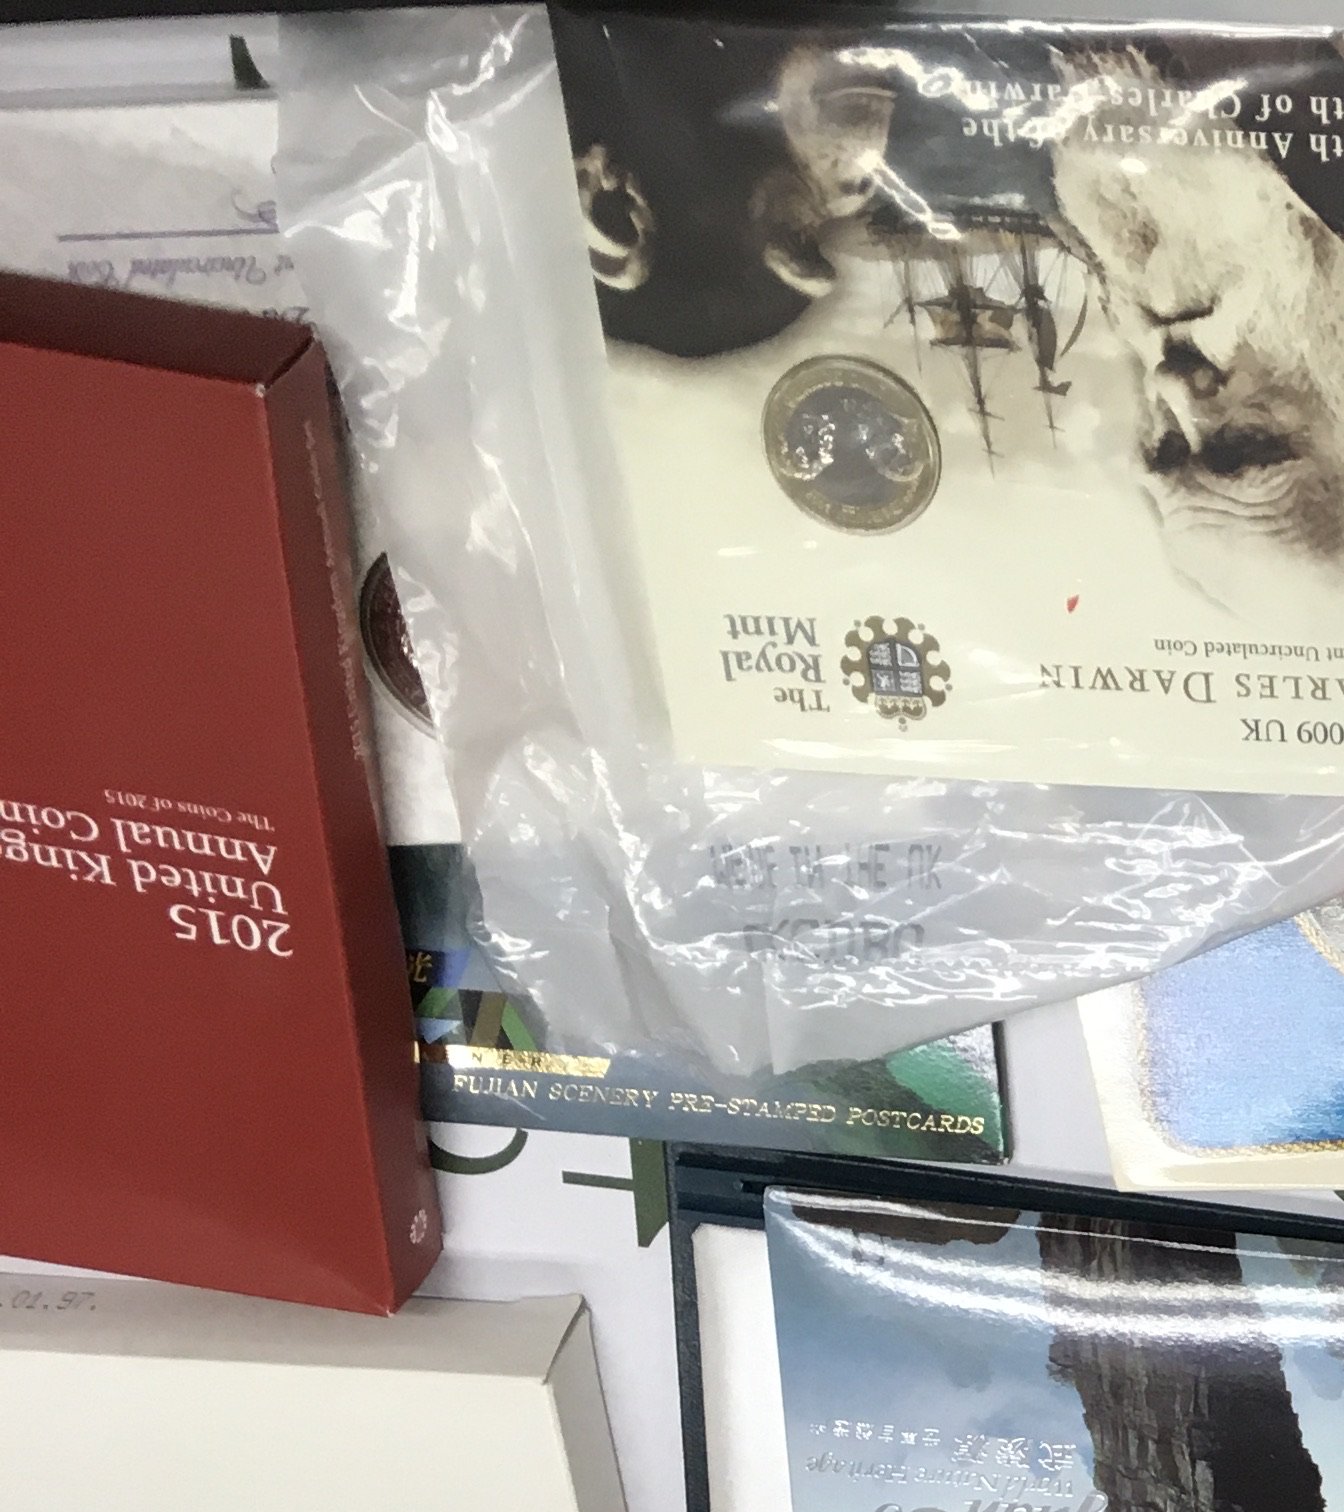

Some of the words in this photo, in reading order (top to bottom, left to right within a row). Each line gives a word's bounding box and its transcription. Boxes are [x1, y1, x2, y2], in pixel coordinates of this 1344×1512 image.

[1110, 84, 1241, 119] Charles
[1255, 93, 1293, 121] of
[961, 116, 1016, 147] the
[1082, 123, 1294, 159] Anniversary
[723, 614, 820, 648] Mint
[1153, 638, 1198, 657] Coin
[719, 641, 826, 683] Royal
[1203, 641, 1320, 662] Uncirculated
[773, 687, 830, 713] The
[1038, 663, 1217, 704] DARWIN
[1240, 718, 1287, 743] UK
[103, 789, 147, 809] 2015
[151, 797, 172, 812] of
[177, 801, 232, 823] Coins
[0, 799, 100, 842] Coin
[236, 811, 275, 832] The
[0, 828, 116, 887] King
[110, 817, 277, 876] Annual
[125, 858, 288, 916] United
[169, 903, 294, 959] 2015
[451, 1073, 540, 1098] FUJIAN
[548, 1082, 659, 1109] SCENERY
[668, 1091, 837, 1123] PRE-STAMPED
[846, 1106, 986, 1136] POSTCARDS
